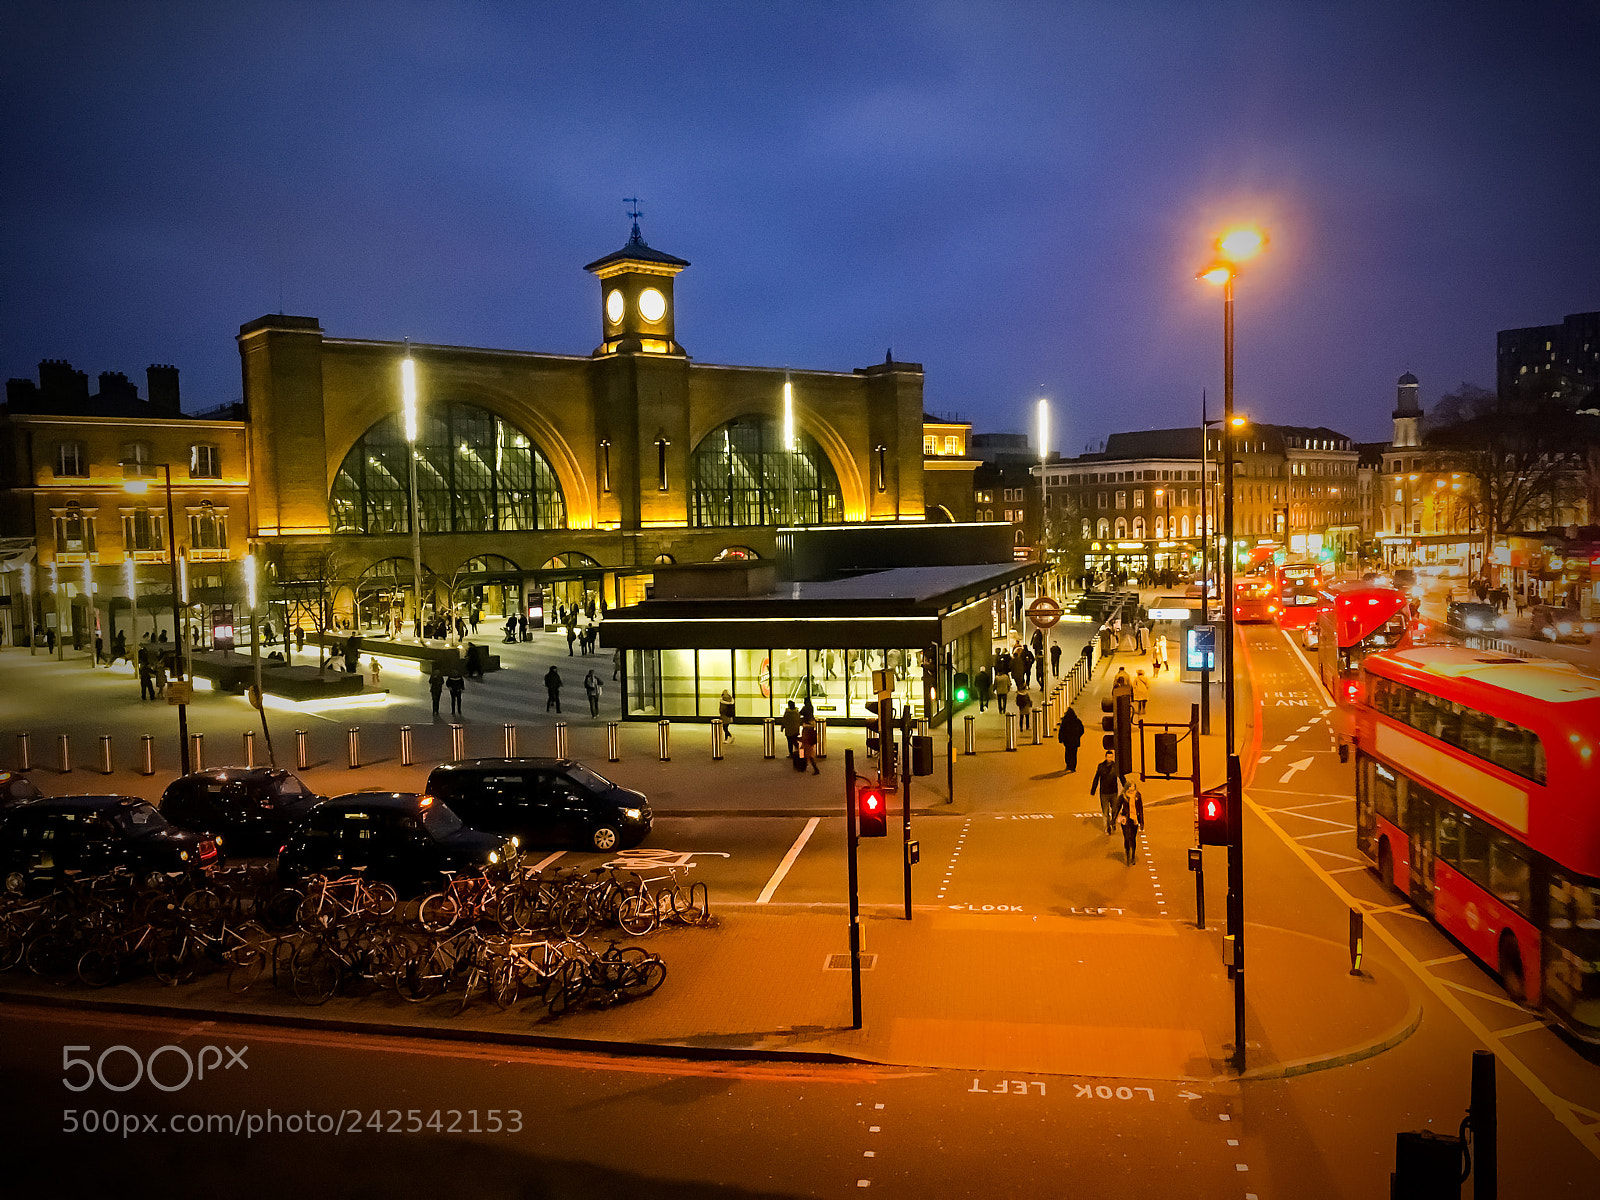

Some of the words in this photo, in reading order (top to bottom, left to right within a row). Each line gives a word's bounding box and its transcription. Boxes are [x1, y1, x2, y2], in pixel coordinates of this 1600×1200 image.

[968, 904, 1024, 912] LOOK
[1070, 907, 1126, 915] LEFT
[967, 1078, 1046, 1096] LEFT
[1073, 1083, 1155, 1101] LOOK
